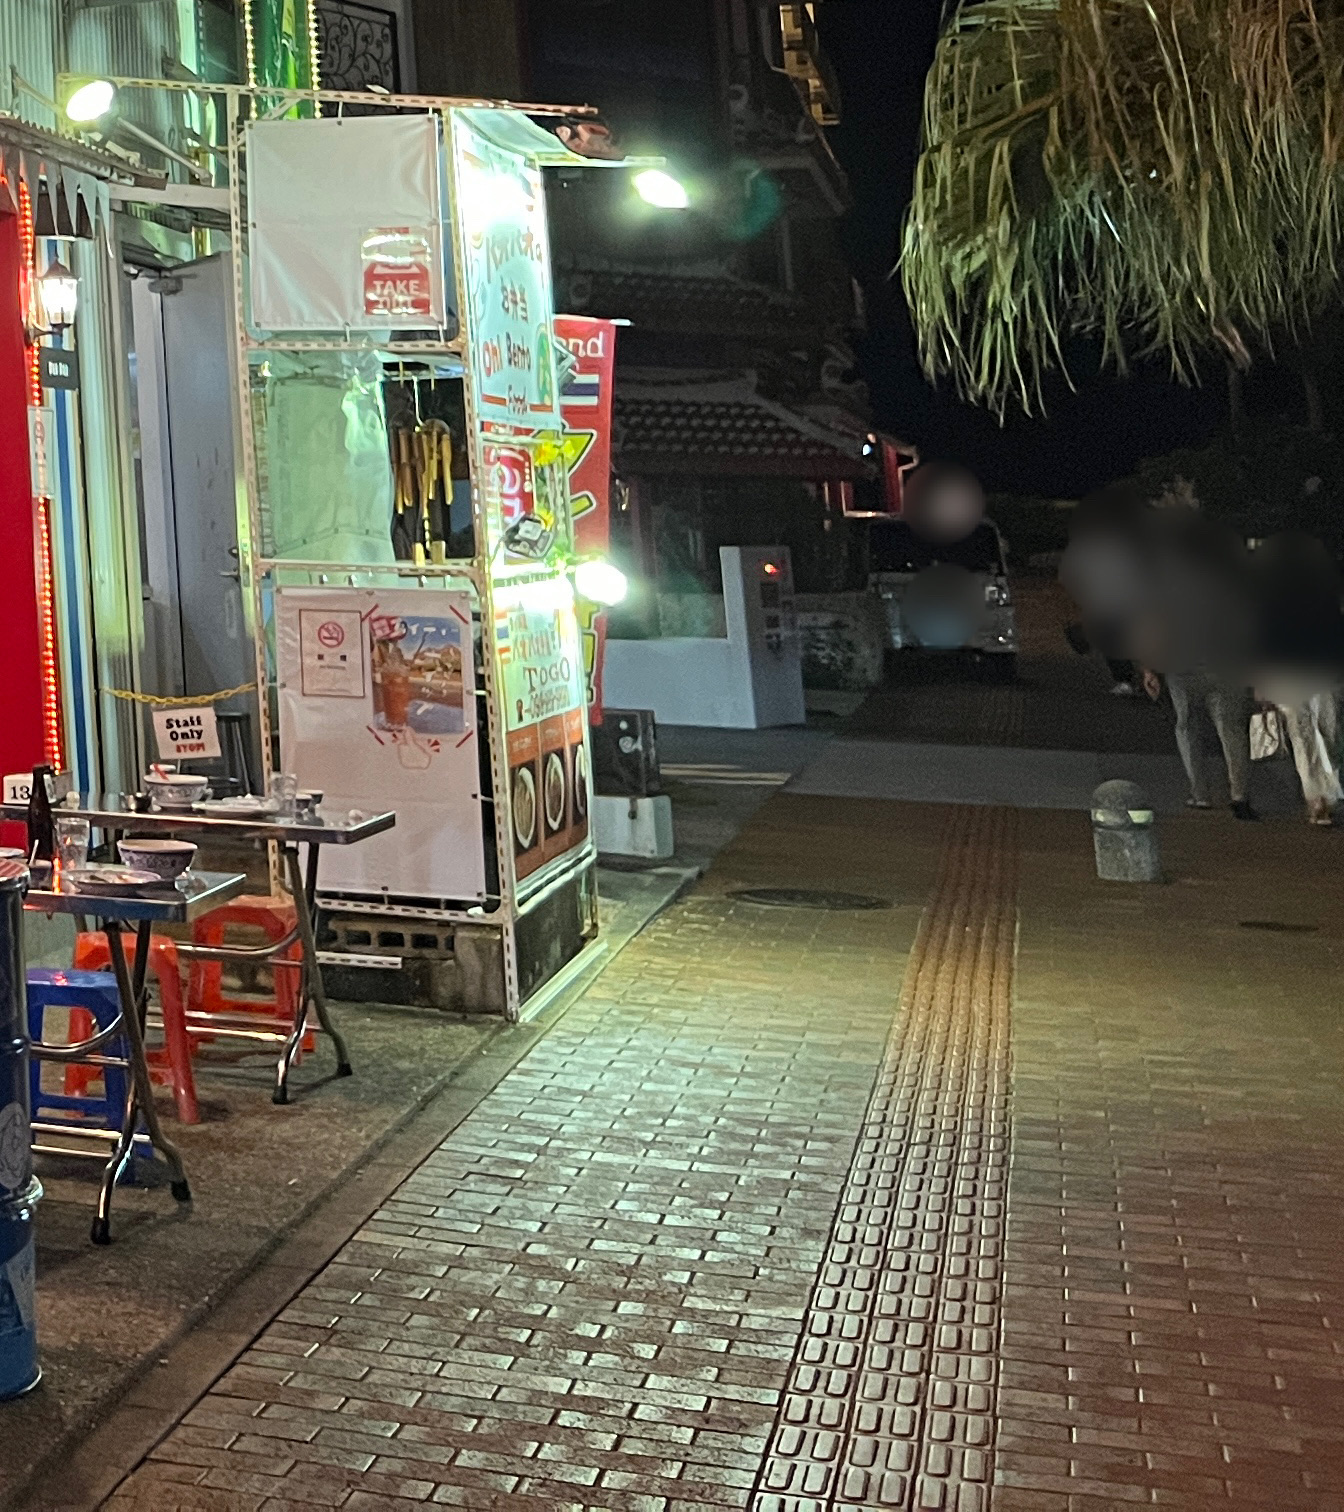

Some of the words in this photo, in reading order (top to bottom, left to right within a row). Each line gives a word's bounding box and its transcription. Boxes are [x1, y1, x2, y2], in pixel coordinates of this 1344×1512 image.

[373, 279, 420, 296] TAKE
[522, 656, 571, 695] TOGO
[165, 716, 203, 730] Staff
[170, 728, 204, 741] Only
[10, 785, 32, 801] 13
